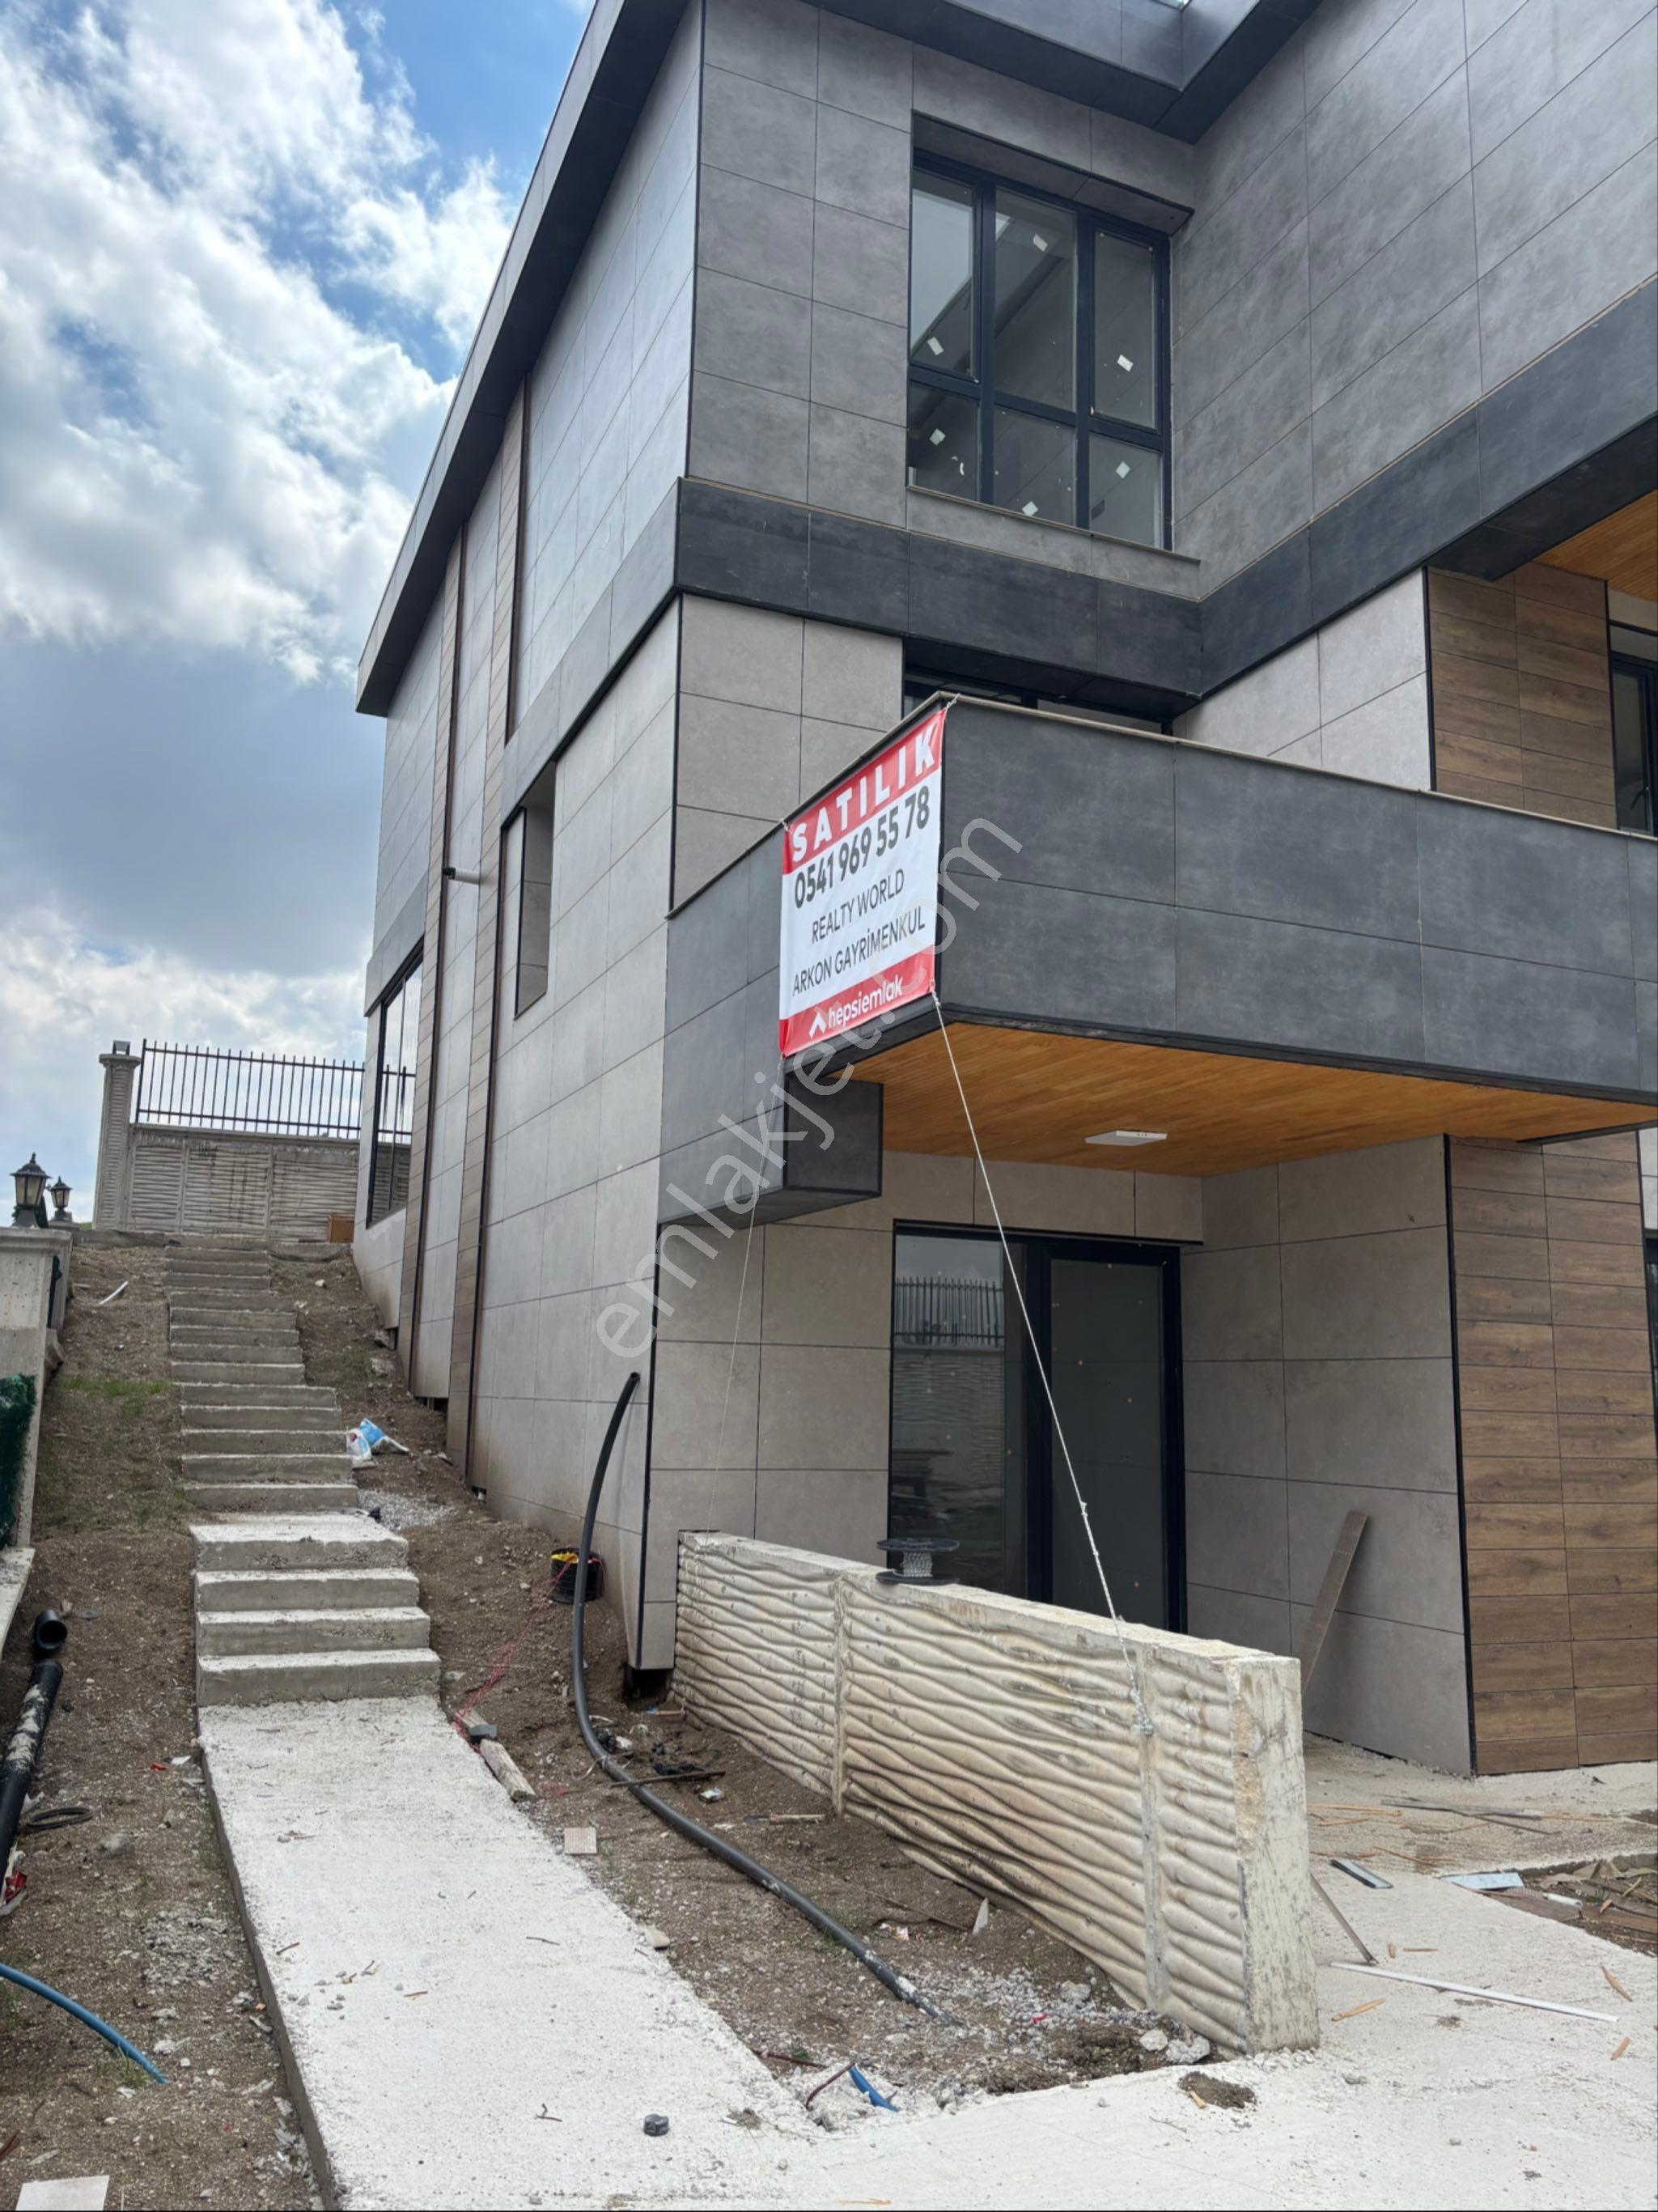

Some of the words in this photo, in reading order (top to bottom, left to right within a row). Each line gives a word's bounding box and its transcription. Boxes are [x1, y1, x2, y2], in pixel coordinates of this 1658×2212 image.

[792, 723, 935, 862] SATILIK
[794, 855, 835, 909] 0541
[838, 829, 871, 881] 969
[876, 813, 899, 857] 55
[905, 785, 930, 839] 78
[792, 955, 832, 997] ARKON
[834, 905, 926, 974] GAYRİMENKUL
[812, 902, 854, 944] REALTY
[857, 868, 905, 918] WORLD
[827, 974, 903, 1030] hepsiemlak
